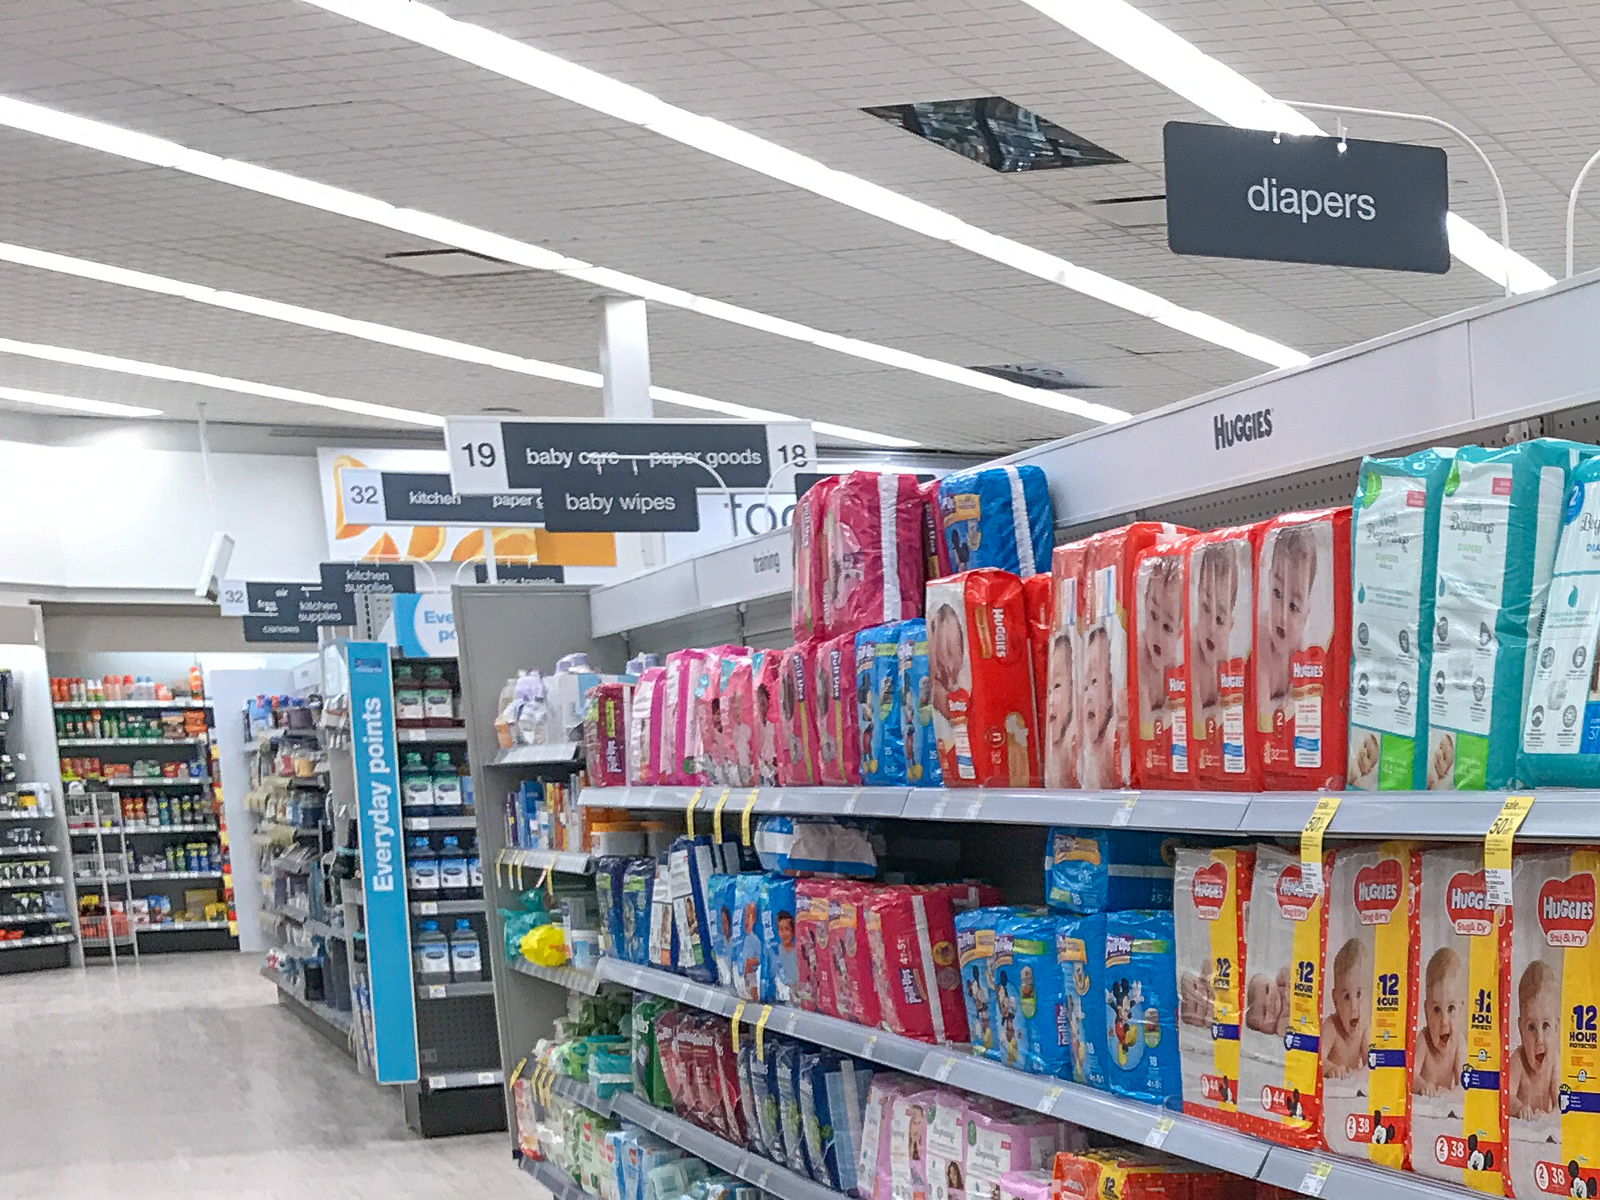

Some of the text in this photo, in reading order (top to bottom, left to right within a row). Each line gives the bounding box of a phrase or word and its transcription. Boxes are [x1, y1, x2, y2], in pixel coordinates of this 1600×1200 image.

[1248, 177, 1376, 221] diapers
[1214, 408, 1272, 450] HUGGIES
[462, 443, 495, 467] 19
[527, 448, 619, 467] baby care
[649, 450, 762, 468] paper goods
[778, 445, 807, 467] 18
[350, 486, 378, 505] 32
[409, 490, 461, 507] kitchen
[493, 492, 531, 510] paper
[566, 494, 613, 514] baby
[620, 494, 675, 514] wipes
[345, 570, 389, 581] kitchen
[225, 590, 244, 603] 32
[345, 583, 394, 594] supplies
[299, 601, 337, 610] kitchen
[298, 612, 341, 623] supplies
[363, 697, 389, 773] points
[372, 782, 395, 892] Everyday
[1358, 883, 1397, 901] HUGGIES
[1543, 896, 1594, 920] HUGGIES
[1379, 974, 1399, 996] 12
[1572, 1005, 1597, 1030] 12
[1569, 1031, 1597, 1043] HOUR
[1358, 1117, 1369, 1133] 38
[1450, 1140, 1464, 1157] 38
[1551, 1167, 1565, 1186] 38
